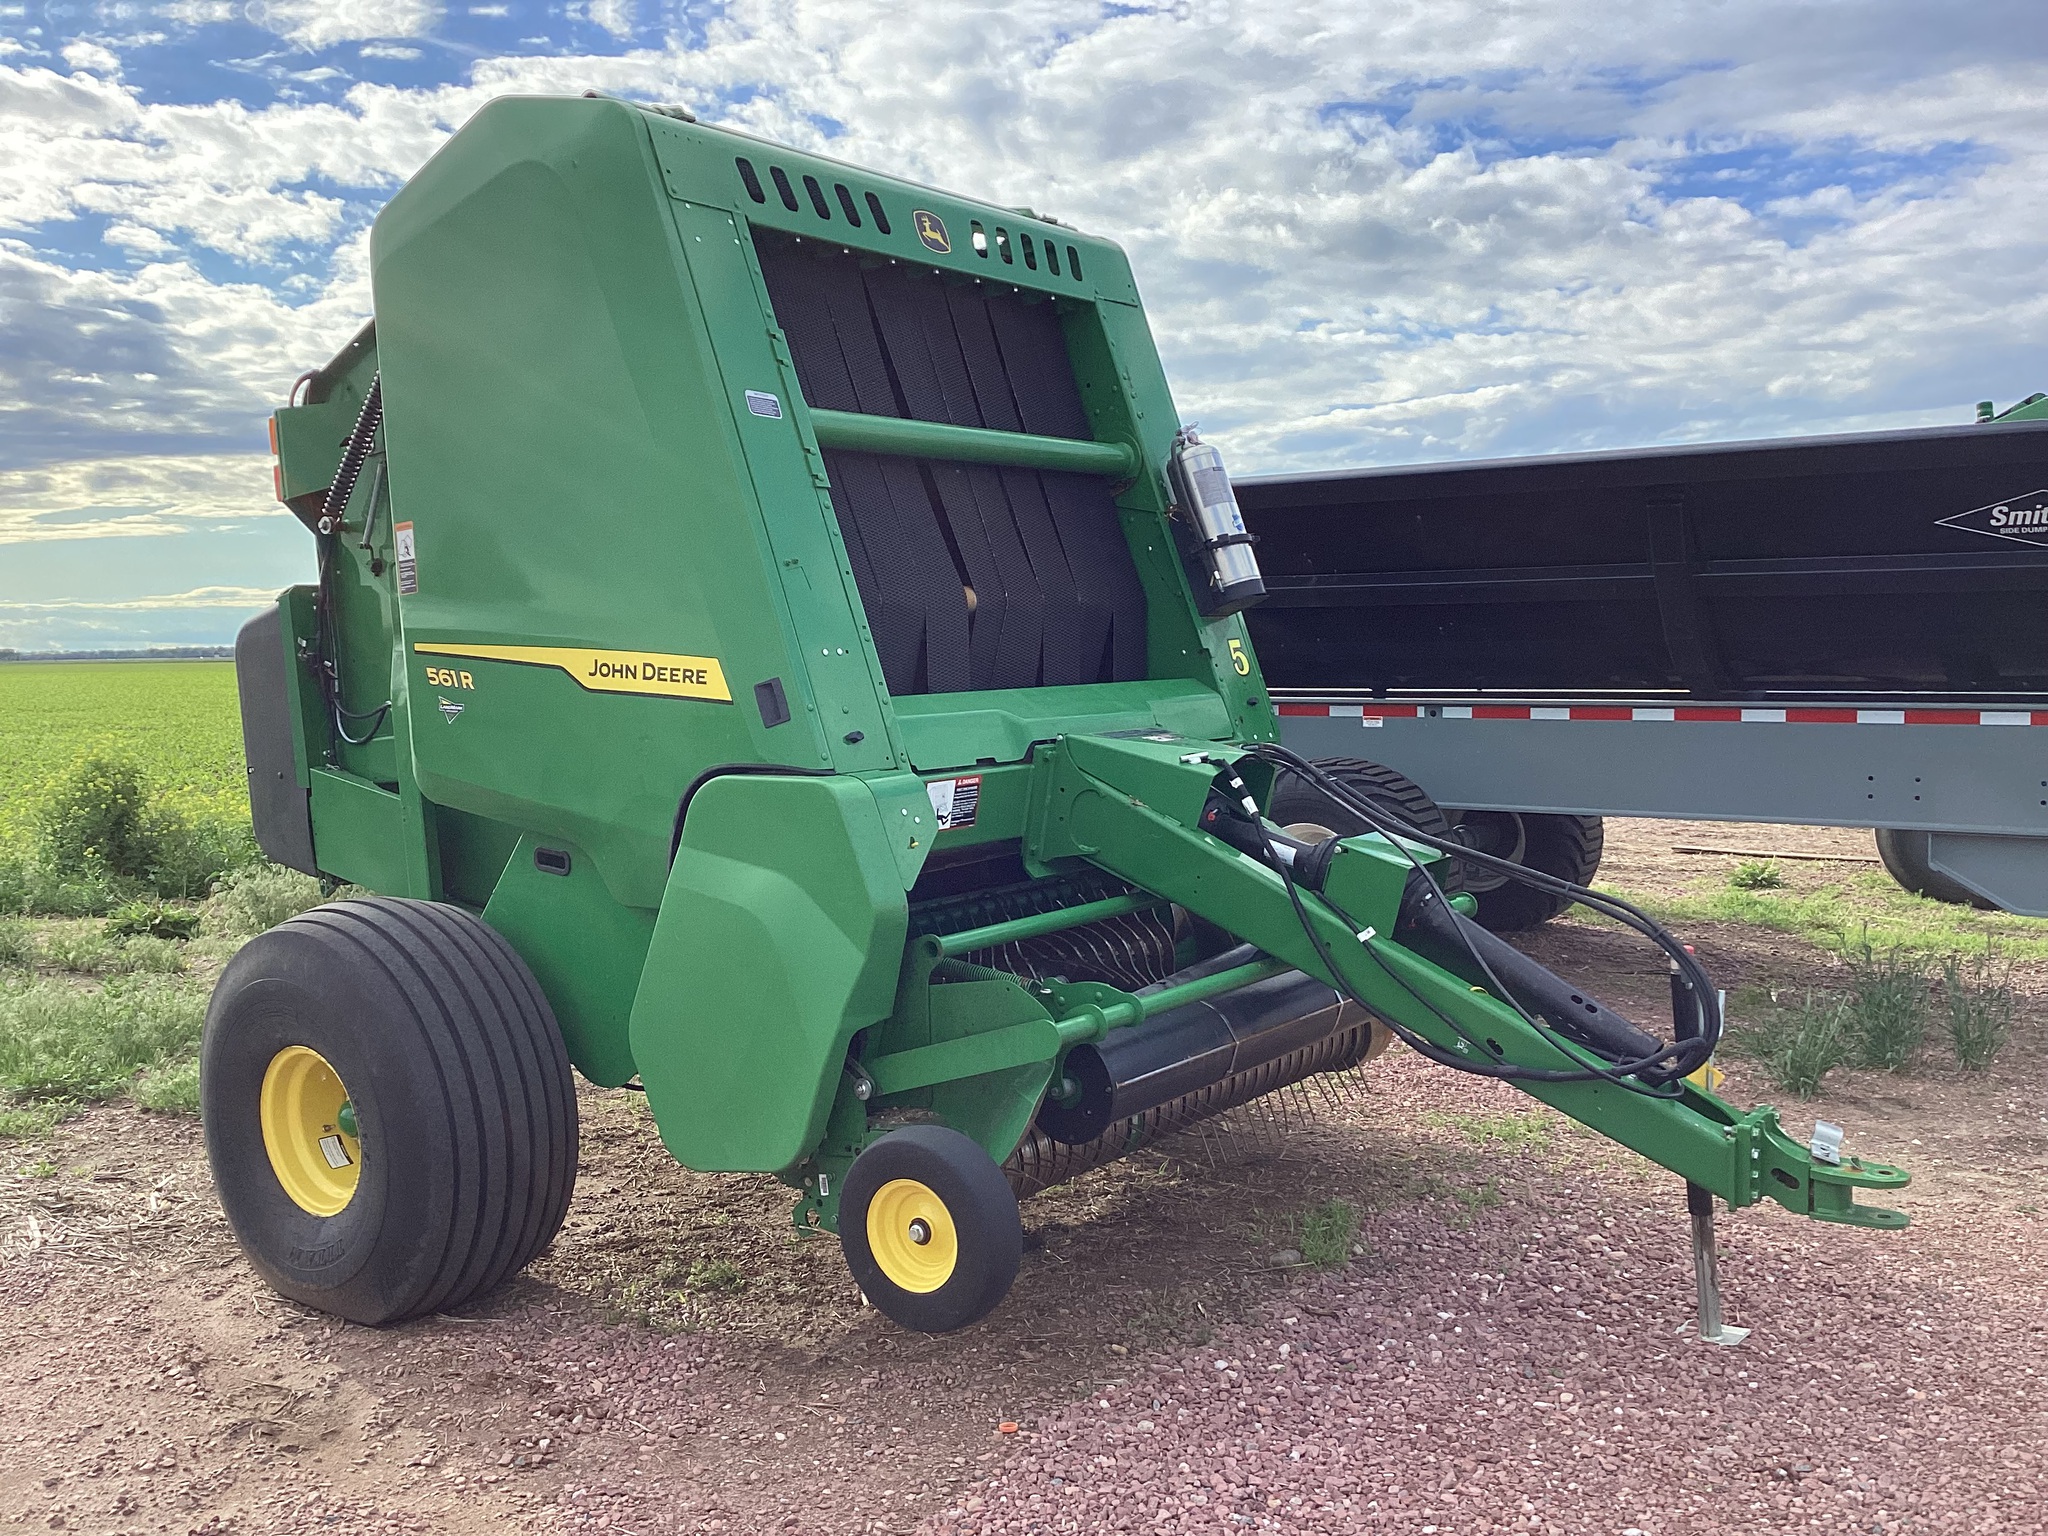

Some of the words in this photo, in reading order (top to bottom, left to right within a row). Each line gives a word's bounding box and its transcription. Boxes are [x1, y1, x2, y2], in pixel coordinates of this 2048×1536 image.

[588, 658, 637, 680] JOHN
[642, 662, 708, 685] DEERE
[1227, 638, 1250, 676] 5
